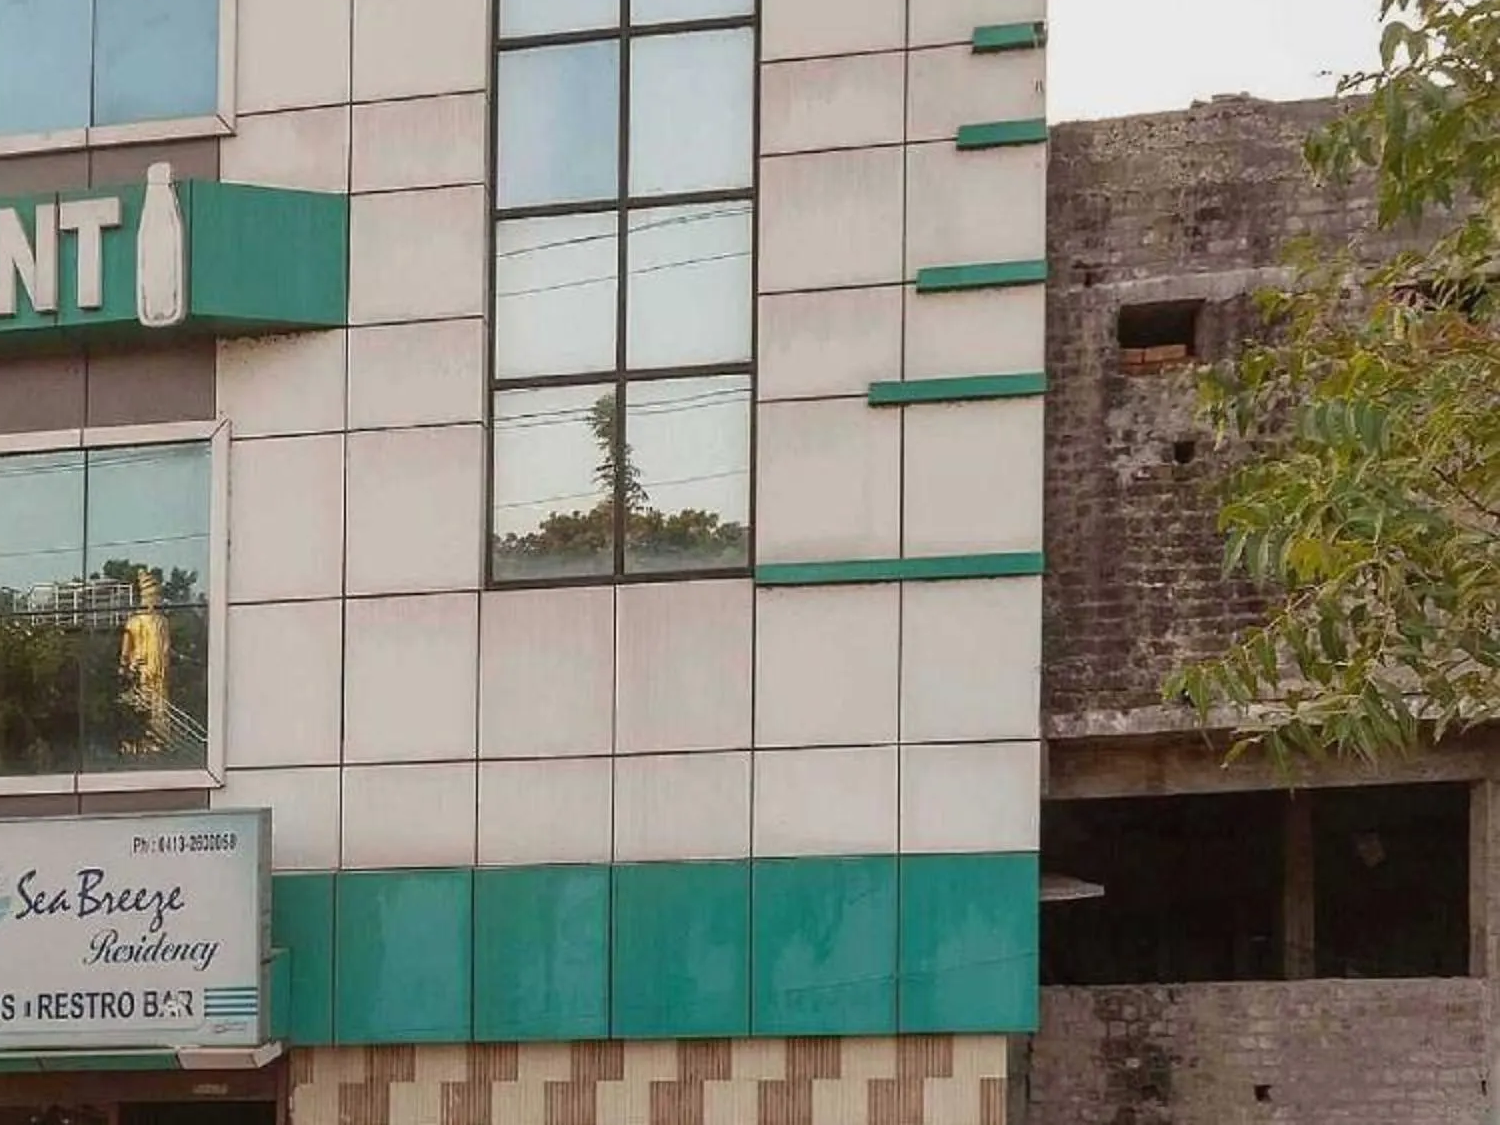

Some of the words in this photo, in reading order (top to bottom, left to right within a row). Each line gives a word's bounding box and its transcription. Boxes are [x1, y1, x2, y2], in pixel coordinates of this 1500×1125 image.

[15, 869, 70, 920] Sea
[77, 869, 185, 932] Breeze
[83, 929, 219, 971] Residency
[37, 992, 136, 1021] RESTRO
